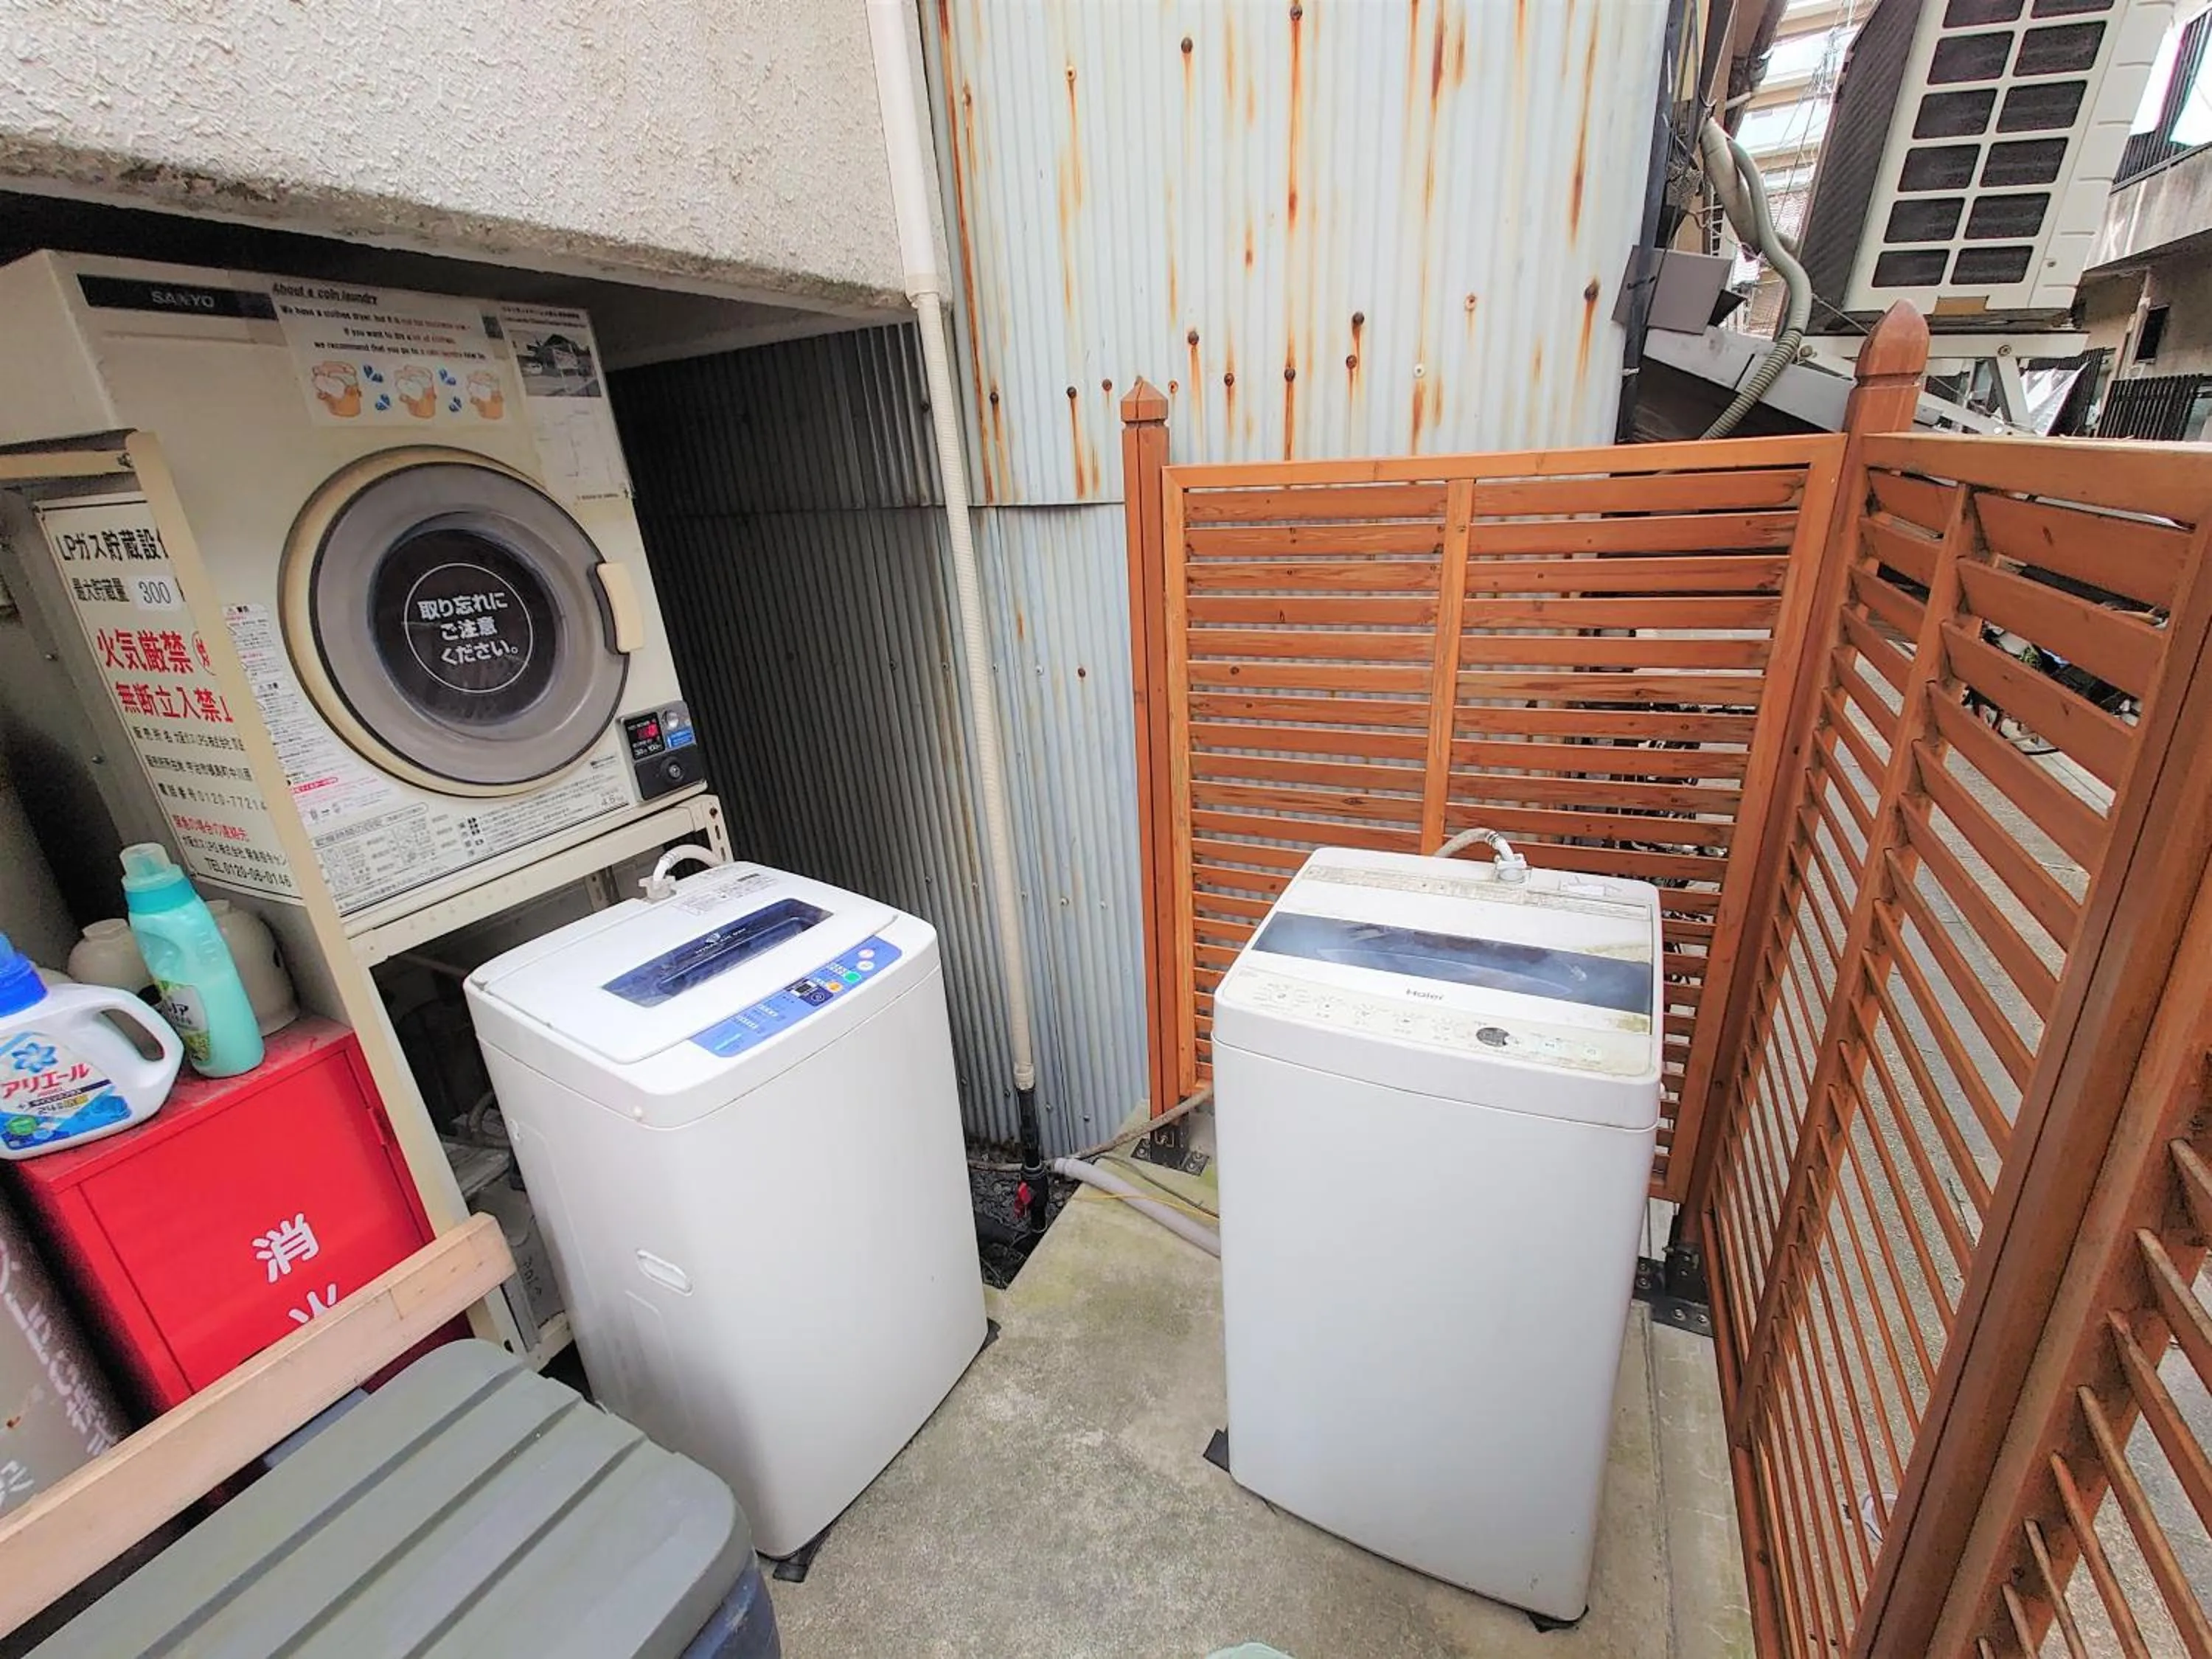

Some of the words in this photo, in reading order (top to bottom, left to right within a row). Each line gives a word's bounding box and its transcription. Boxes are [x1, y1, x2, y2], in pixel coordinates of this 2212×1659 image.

[151, 291, 215, 308] SANYO
[273, 282, 304, 296] About
[55, 528, 169, 561] LPガス貯蔵設
[139, 581, 172, 604] 300
[417, 592, 508, 620] 取り忘れに
[440, 616, 498, 641] ご注意
[441, 640, 518, 665] ください。
[1406, 988, 1444, 1001] Haier
[1, 1062, 91, 1099] アリエール
